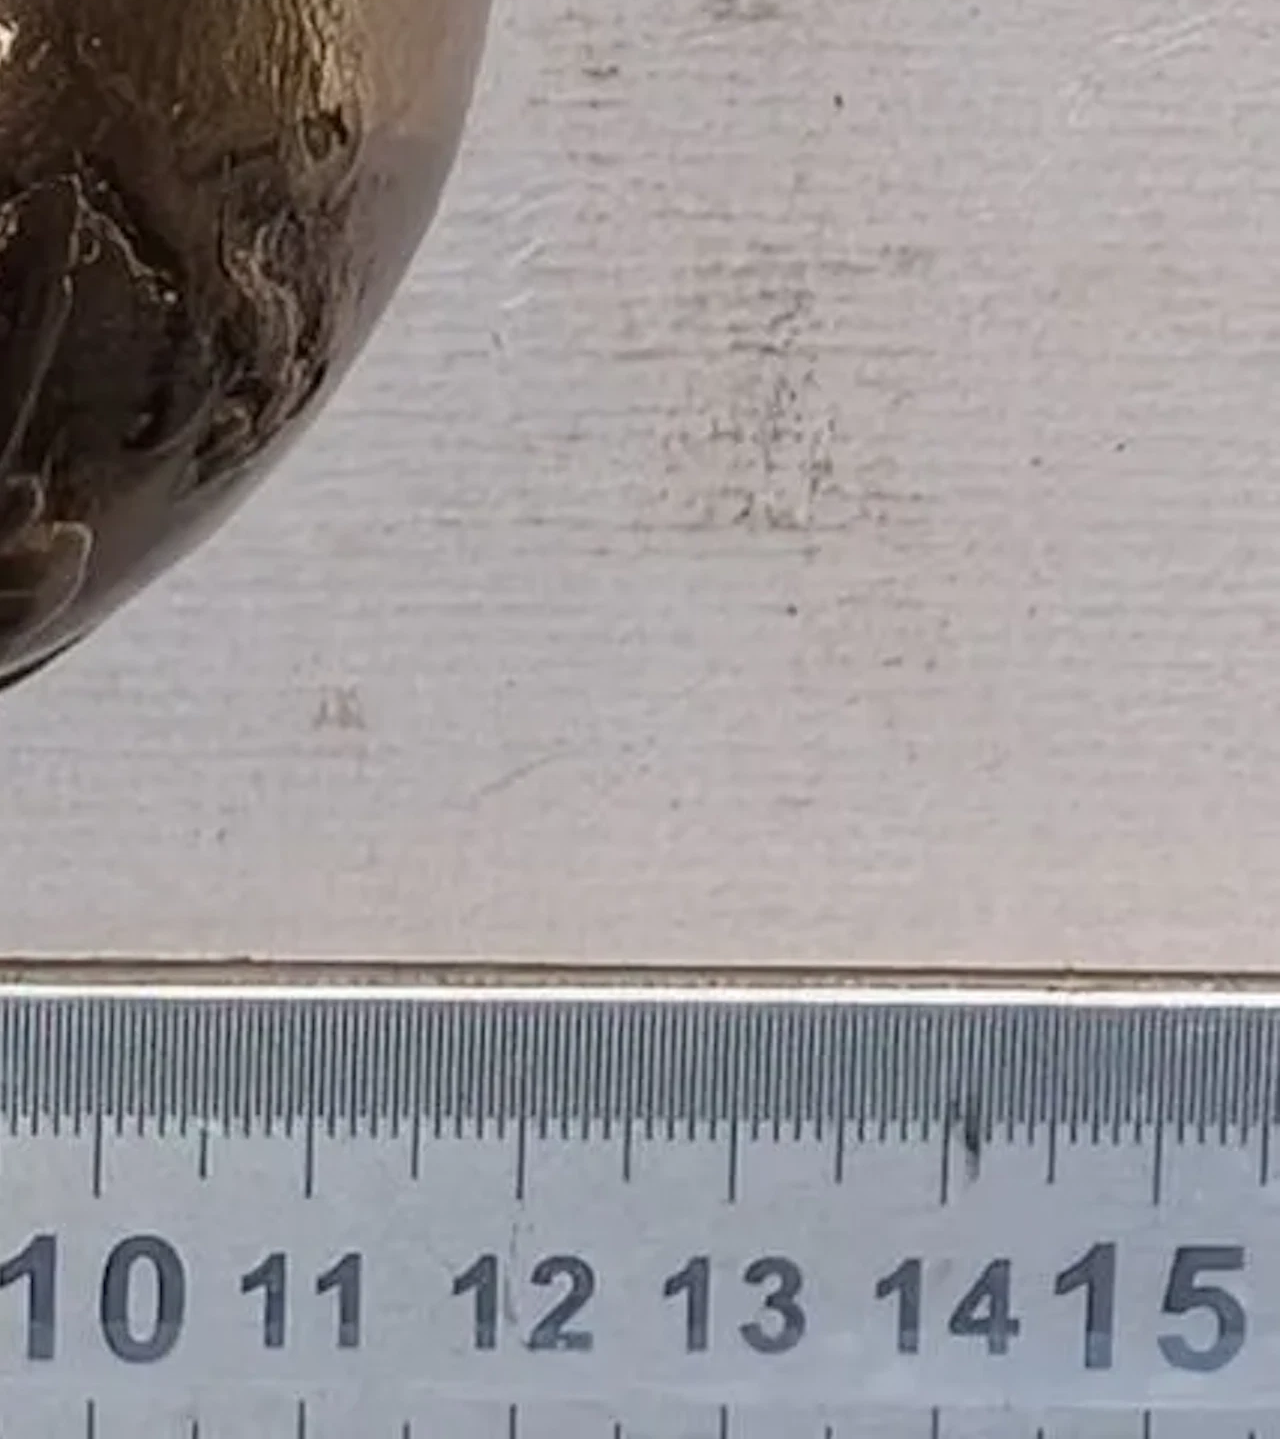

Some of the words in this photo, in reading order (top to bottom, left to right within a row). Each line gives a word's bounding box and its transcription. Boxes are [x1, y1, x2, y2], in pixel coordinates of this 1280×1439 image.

[239, 1251, 364, 1350] 11
[450, 1253, 596, 1353] 12
[661, 1255, 807, 1355] 13
[874, 1257, 1021, 1356] 14
[1052, 1240, 1247, 1373] 15
